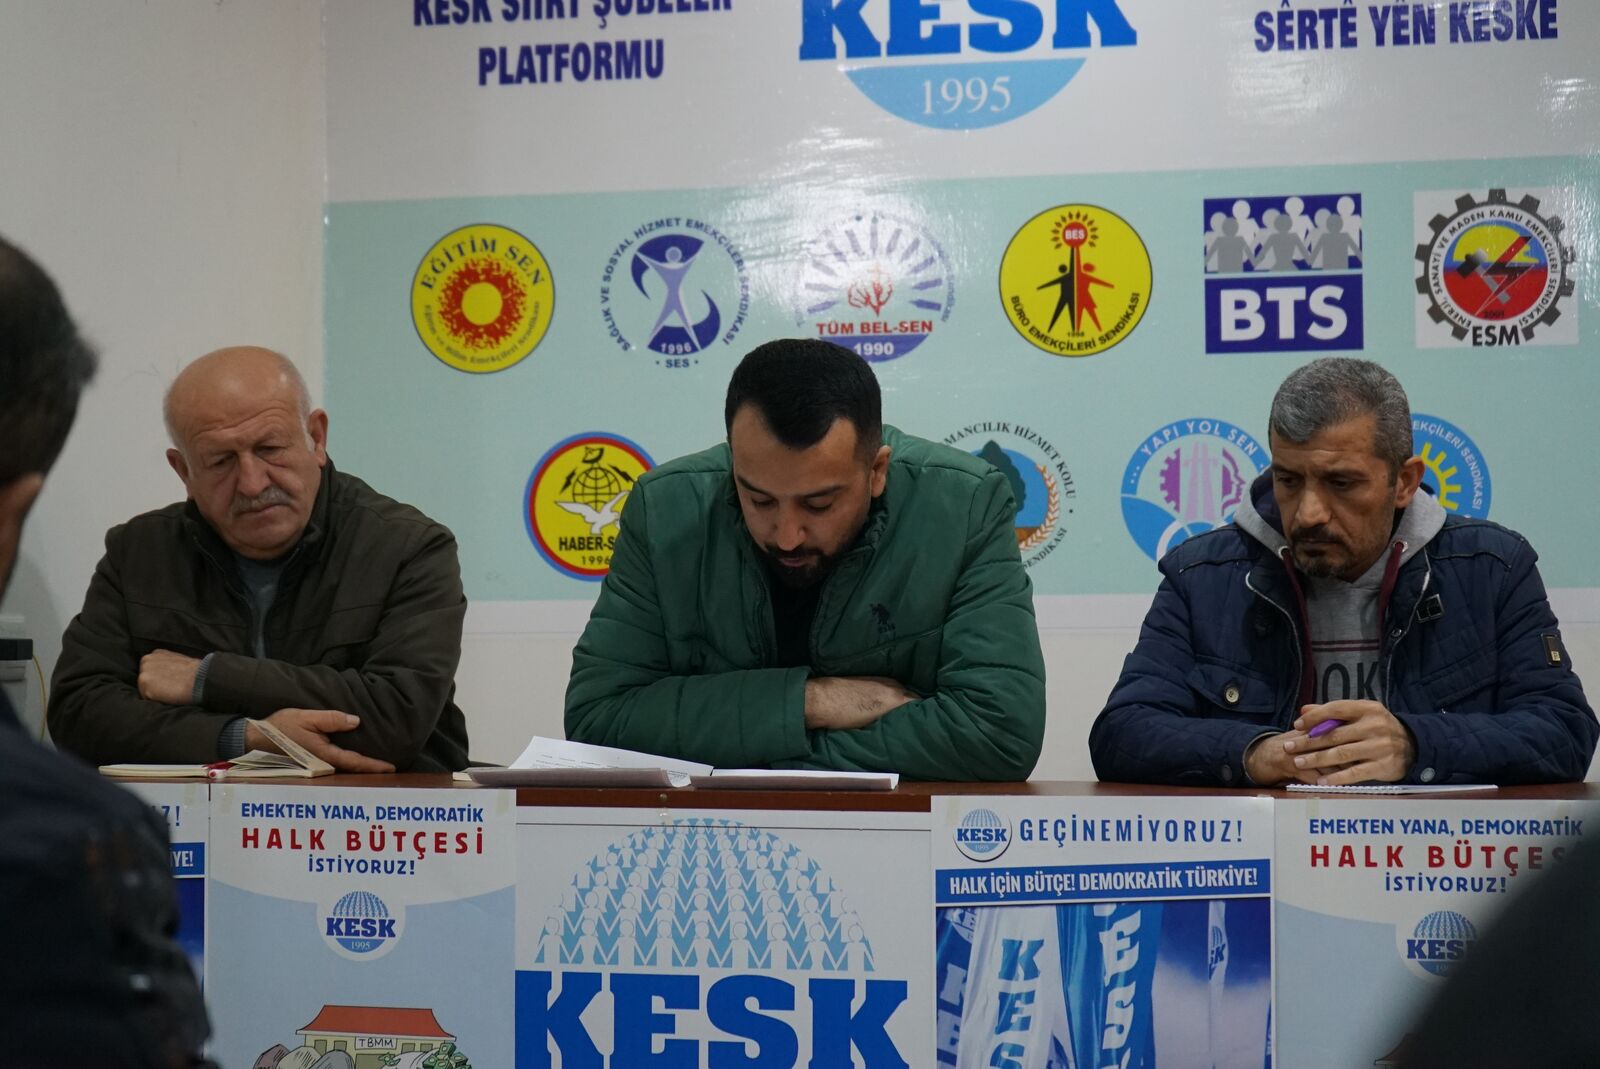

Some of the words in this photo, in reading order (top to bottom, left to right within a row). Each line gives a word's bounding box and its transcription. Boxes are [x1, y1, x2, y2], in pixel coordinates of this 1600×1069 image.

[413, 0, 492, 26] KESK
[799, 0, 1137, 61] KESK
[479, 39, 664, 86] PLATFORMU
[922, 76, 1011, 115] 1995
[634, 217, 681, 239] HİZMET
[1065, 229, 1085, 240] BES
[1439, 236, 1449, 249] VE
[1448, 211, 1485, 237] MADEN
[1489, 209, 1523, 221] KAMU
[420, 235, 497, 290] EĞİTİM
[505, 245, 545, 286] SEN
[603, 238, 634, 283] SOSYAL
[600, 286, 609, 304] VE
[1011, 296, 1030, 327] BÜRO
[1028, 325, 1097, 351] EMEKÇİLERİ
[1098, 292, 1141, 344] SENDİKASI
[1220, 284, 1348, 341] BTS
[816, 320, 854, 335] TÜM
[860, 320, 933, 334] BEL-SEN
[1472, 325, 1520, 347] ESM
[854, 342, 894, 356] 1990
[665, 358, 690, 369] SES
[1141, 425, 1179, 456] YAPI
[1187, 420, 1220, 435] YOL
[1228, 428, 1258, 455] SEN
[1413, 420, 1465, 449] EKÇİLERİ
[944, 422, 1011, 446] MANCILIK
[1014, 425, 1061, 462] HİZMET
[1056, 462, 1077, 499] KOLU
[559, 536, 616, 551] HABER-S
[582, 556, 610, 565] 1996
[241, 802, 316, 819] EMEKTEN
[321, 805, 370, 822] YANA,
[376, 804, 484, 823] DEMOKRATİK
[957, 828, 1007, 842] KESK
[1019, 814, 1243, 848] GEÇİNEMİYORUZ!
[1309, 819, 1394, 835] EMEKTEN
[1400, 819, 1455, 837] YANA,
[1461, 816, 1583, 836] DEMOKRATİK
[242, 827, 325, 850] HALK
[346, 825, 483, 860] BÜTÇESİ
[308, 854, 415, 875] İSTİYORUZ!
[1310, 845, 1404, 868] HALK
[1428, 839, 1567, 876] BÜTÇES
[950, 876, 988, 895] HALK
[990, 871, 1021, 898] İÇİN
[1025, 871, 1076, 897] BÜTÇE!
[1079, 866, 1181, 891] DEMOKRATİK
[1186, 864, 1258, 888] TÜRKİYE!
[1385, 872, 1506, 893] İSTİYORUZ!
[326, 917, 396, 938] KESK
[1407, 939, 1465, 960] KES
[989, 938, 1044, 1069] KES
[515, 970, 910, 1069] KESK
[359, 1037, 394, 1048] TBMM
